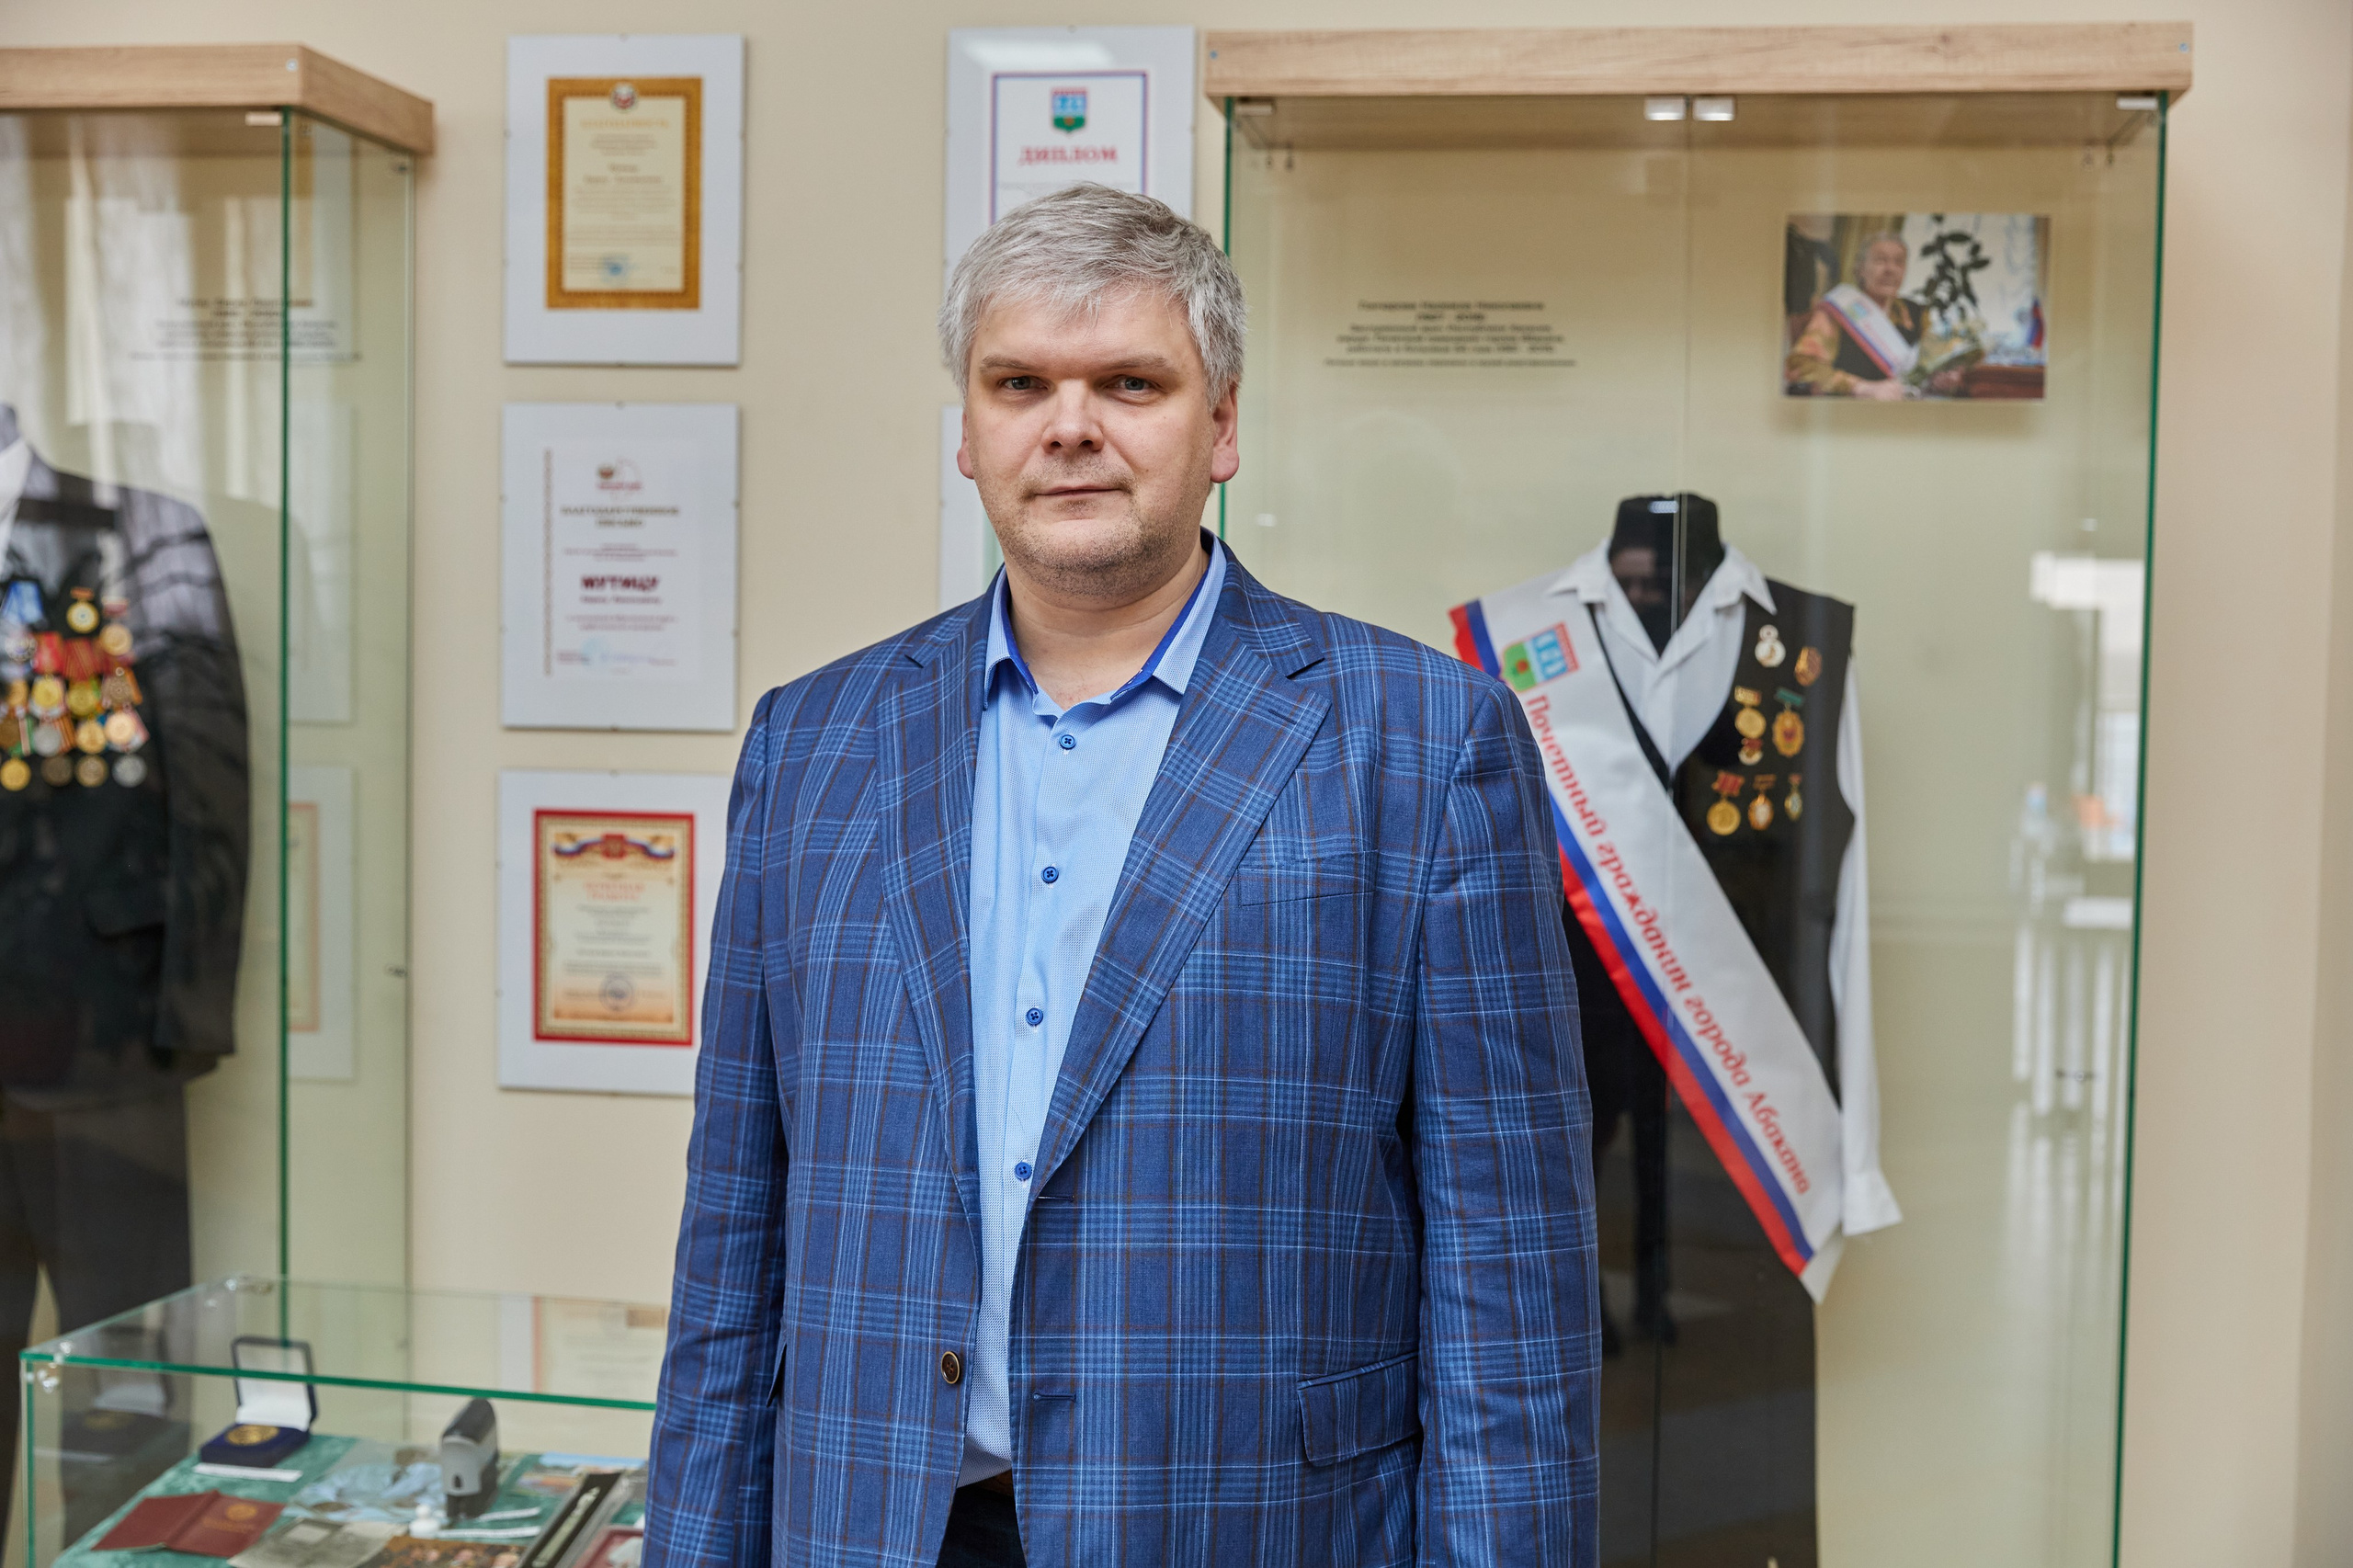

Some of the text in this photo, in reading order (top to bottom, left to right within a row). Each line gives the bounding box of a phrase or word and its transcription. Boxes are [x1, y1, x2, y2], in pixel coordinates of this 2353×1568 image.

[1017, 145, 1118, 165] ДИПЛОМ
[1526, 694, 1812, 1195] Почетный гражданин города Абакана
